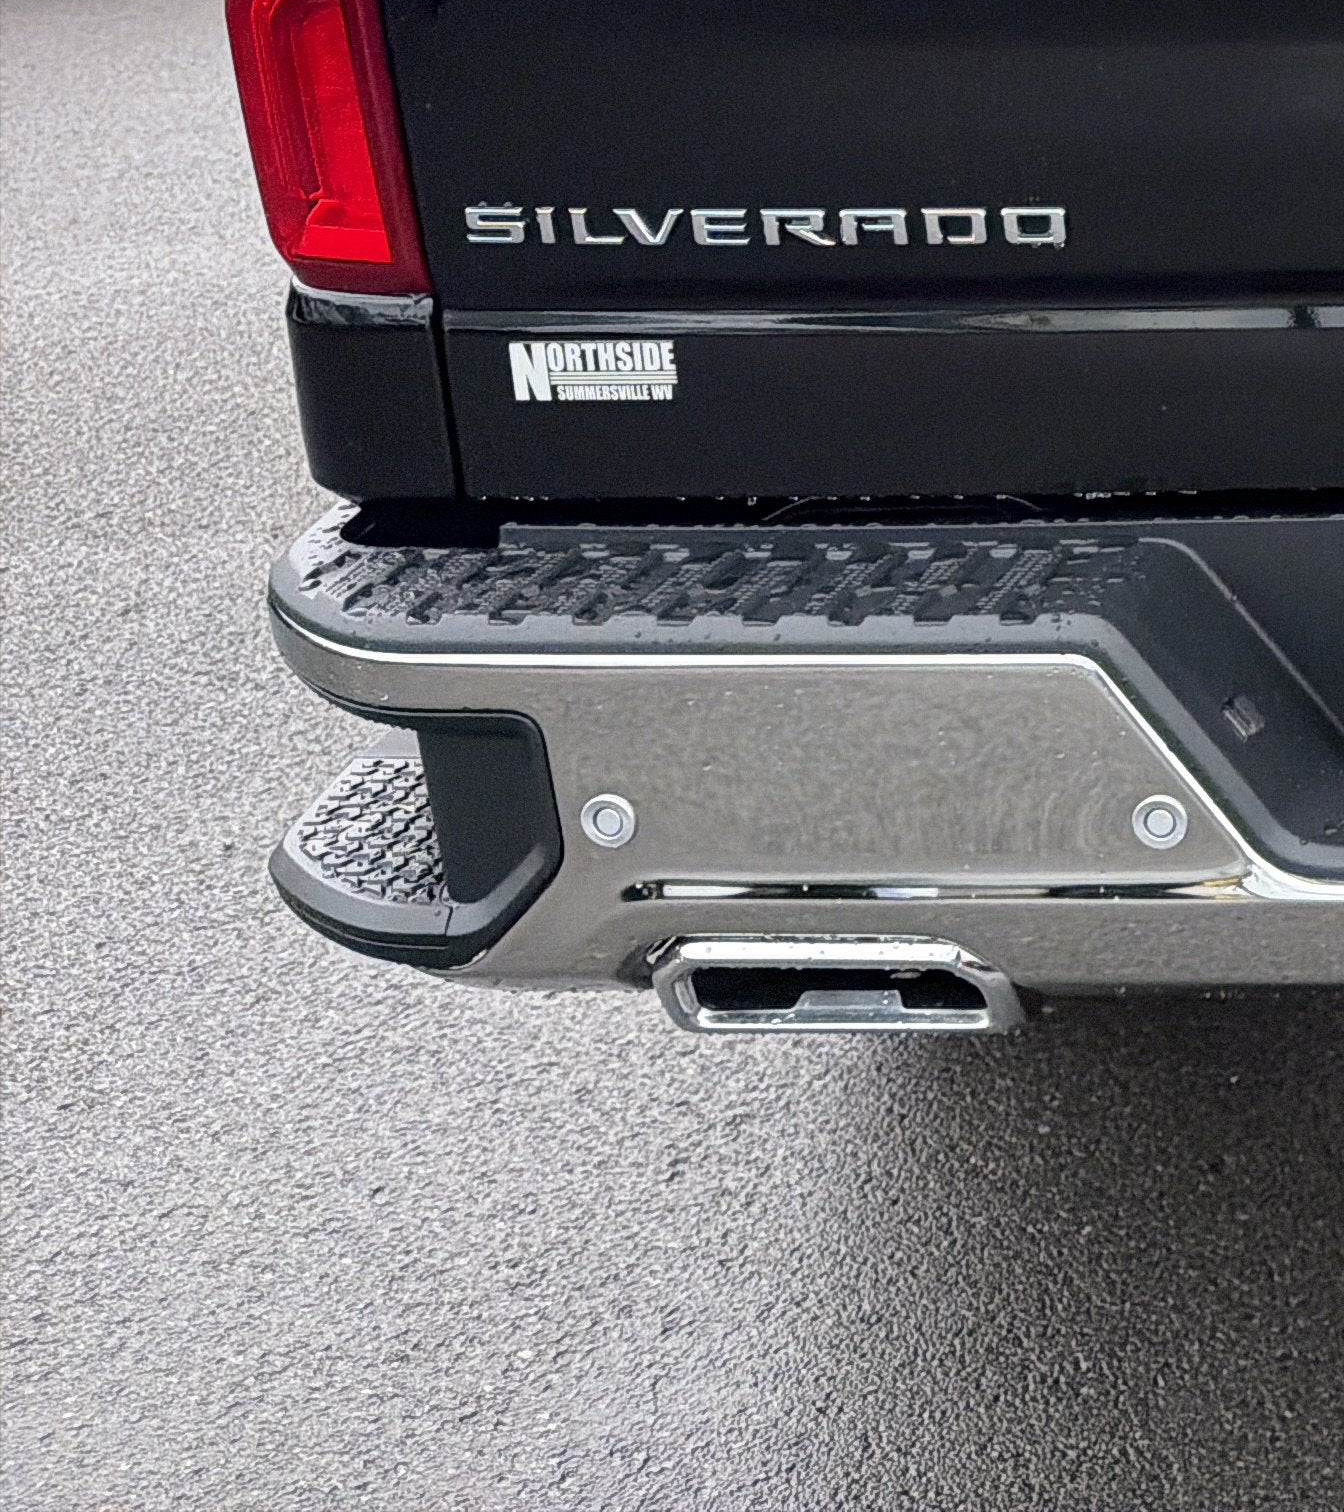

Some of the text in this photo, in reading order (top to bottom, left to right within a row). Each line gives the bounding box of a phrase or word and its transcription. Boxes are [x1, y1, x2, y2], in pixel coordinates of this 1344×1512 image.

[464, 205, 1067, 246] SILVERADO
[508, 341, 677, 401] NORTHSIDE
[556, 384, 674, 401] SUMMERSVILLE WV
